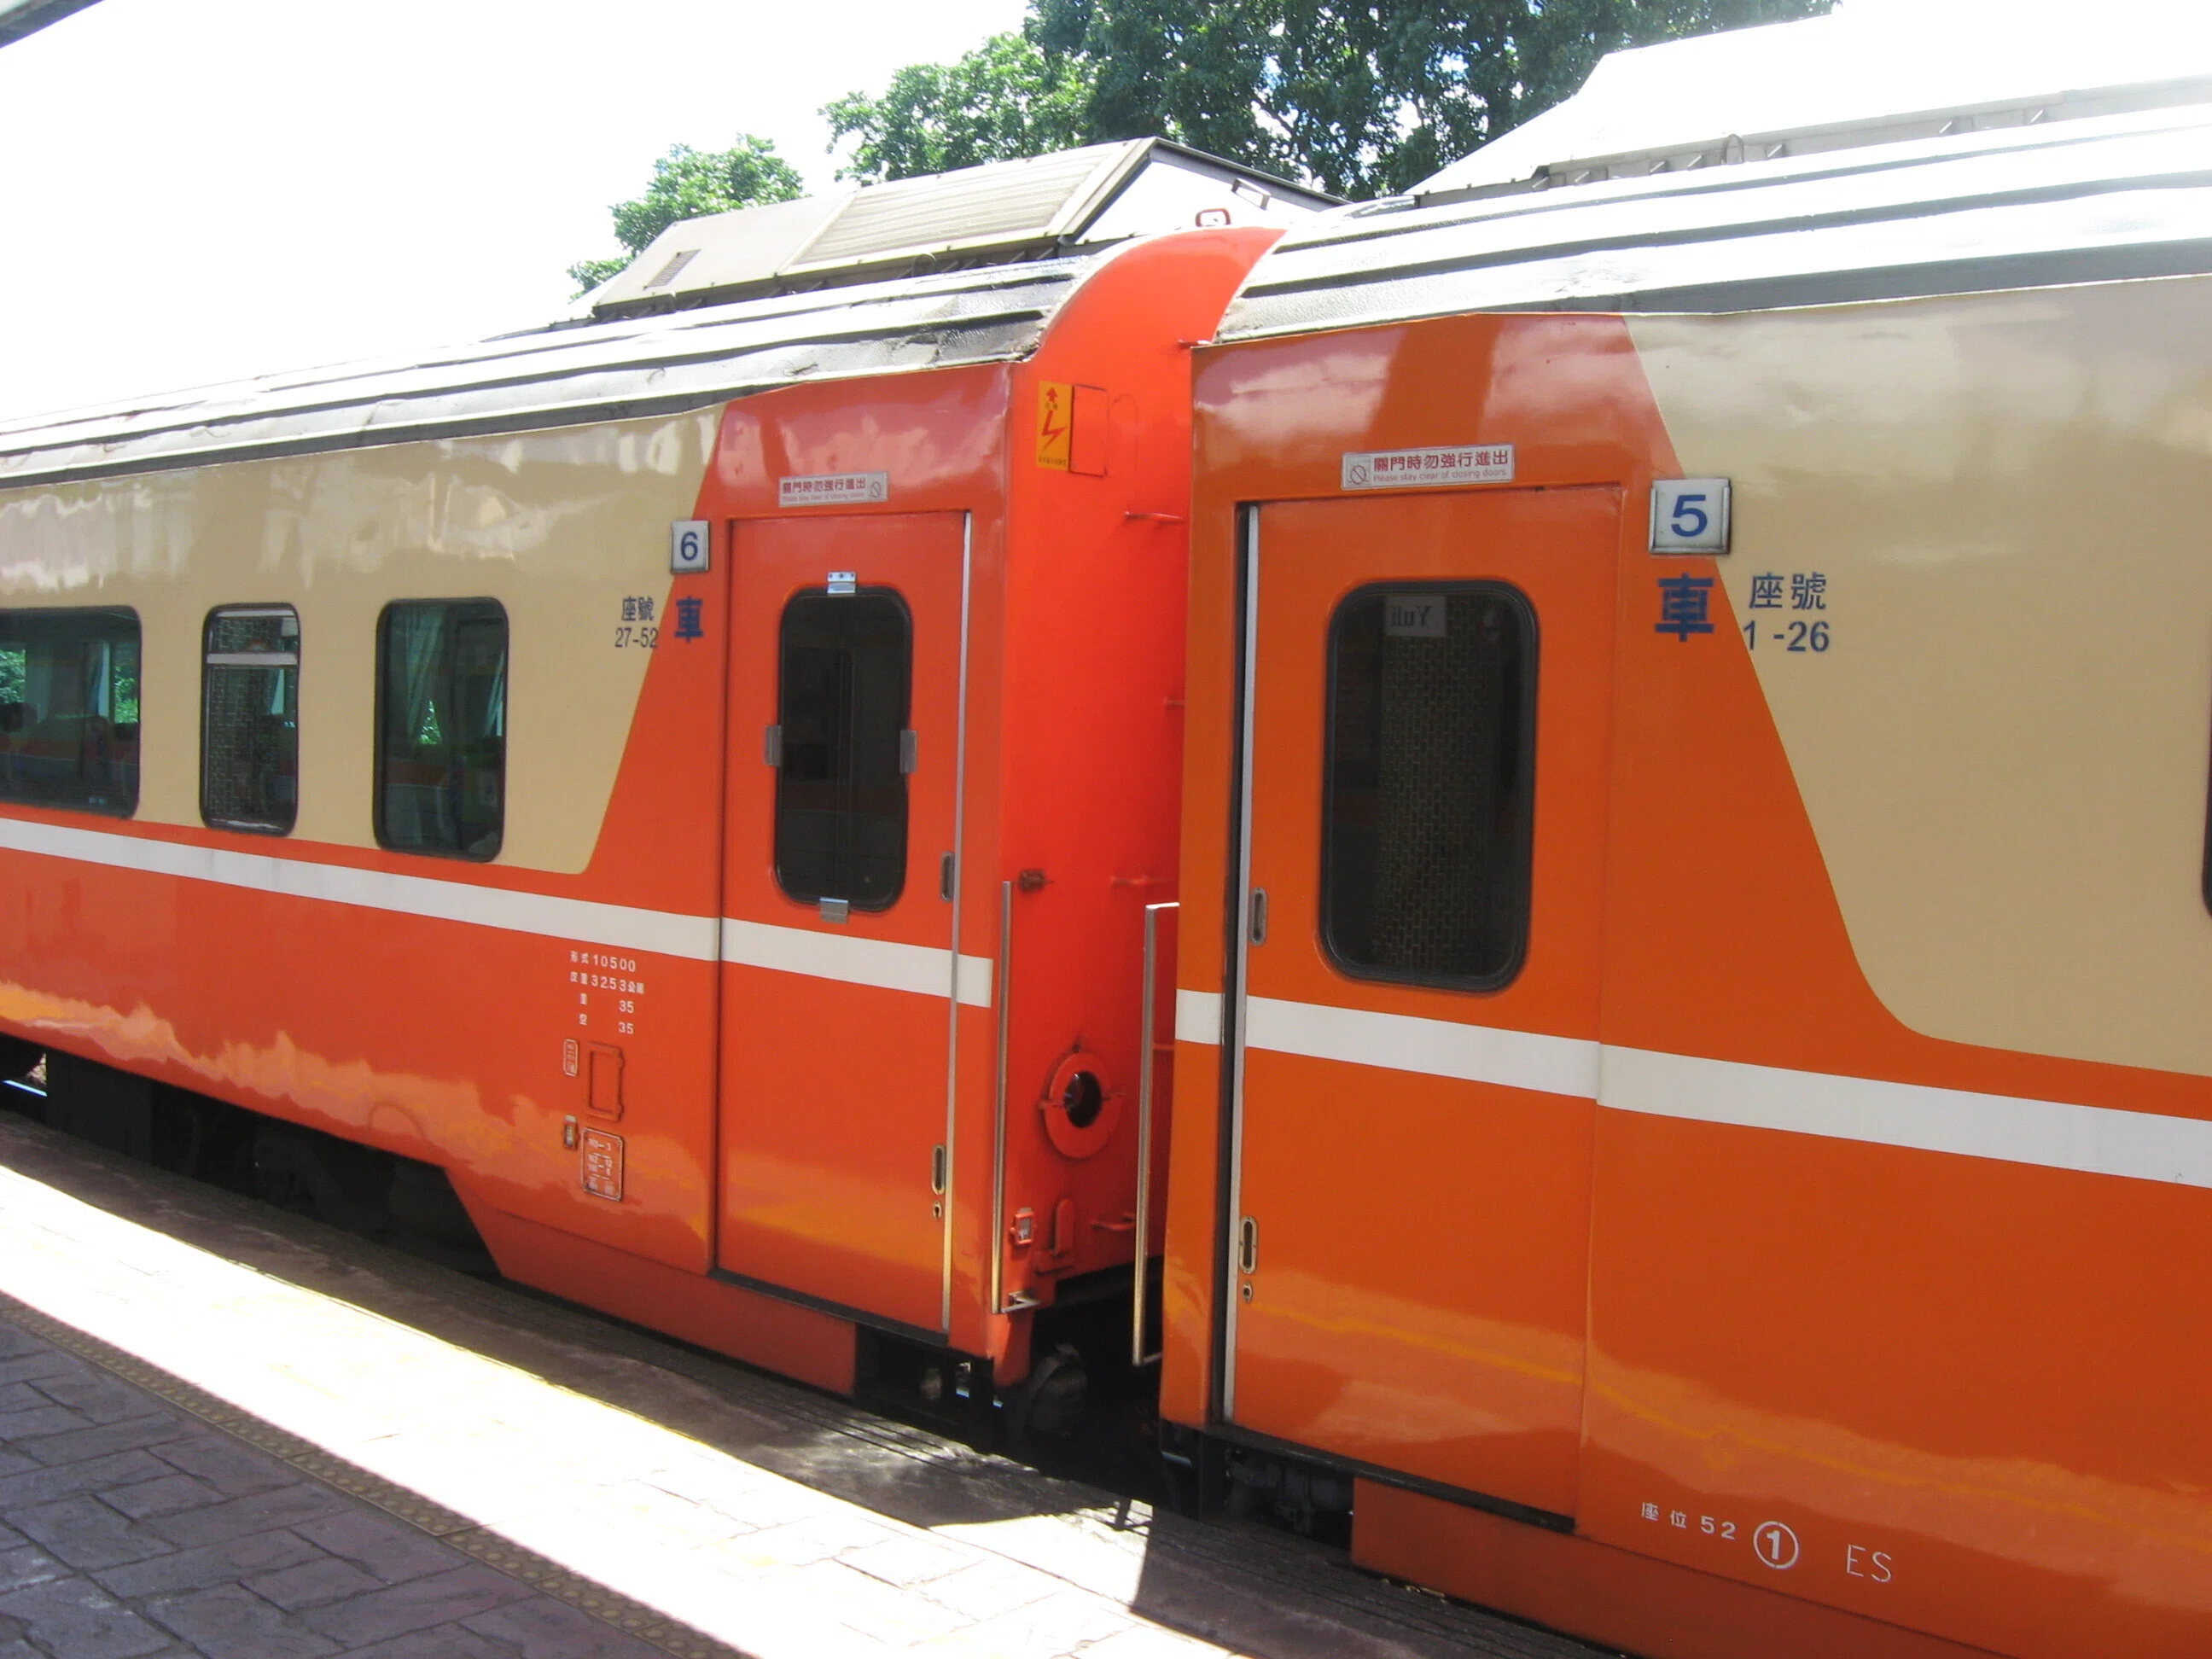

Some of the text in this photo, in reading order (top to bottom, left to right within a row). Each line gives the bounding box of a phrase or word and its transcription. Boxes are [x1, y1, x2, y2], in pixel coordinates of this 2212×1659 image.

[1374, 450, 1508, 472] 關門時勿強行進出
[1452, 470, 1480, 479] closing
[1482, 469, 1506, 477] doors
[1671, 494, 1708, 538] 5
[680, 531, 698, 562] 6
[1749, 572, 1827, 611] 座號
[621, 596, 654, 621] 座號
[674, 596, 704, 643] 車
[1654, 572, 1714, 642] 車
[614, 626, 659, 649] 27-52
[619, 999, 635, 1014] 35
[618, 1022, 634, 1035] 35
[1846, 1544, 1892, 1582] ES
